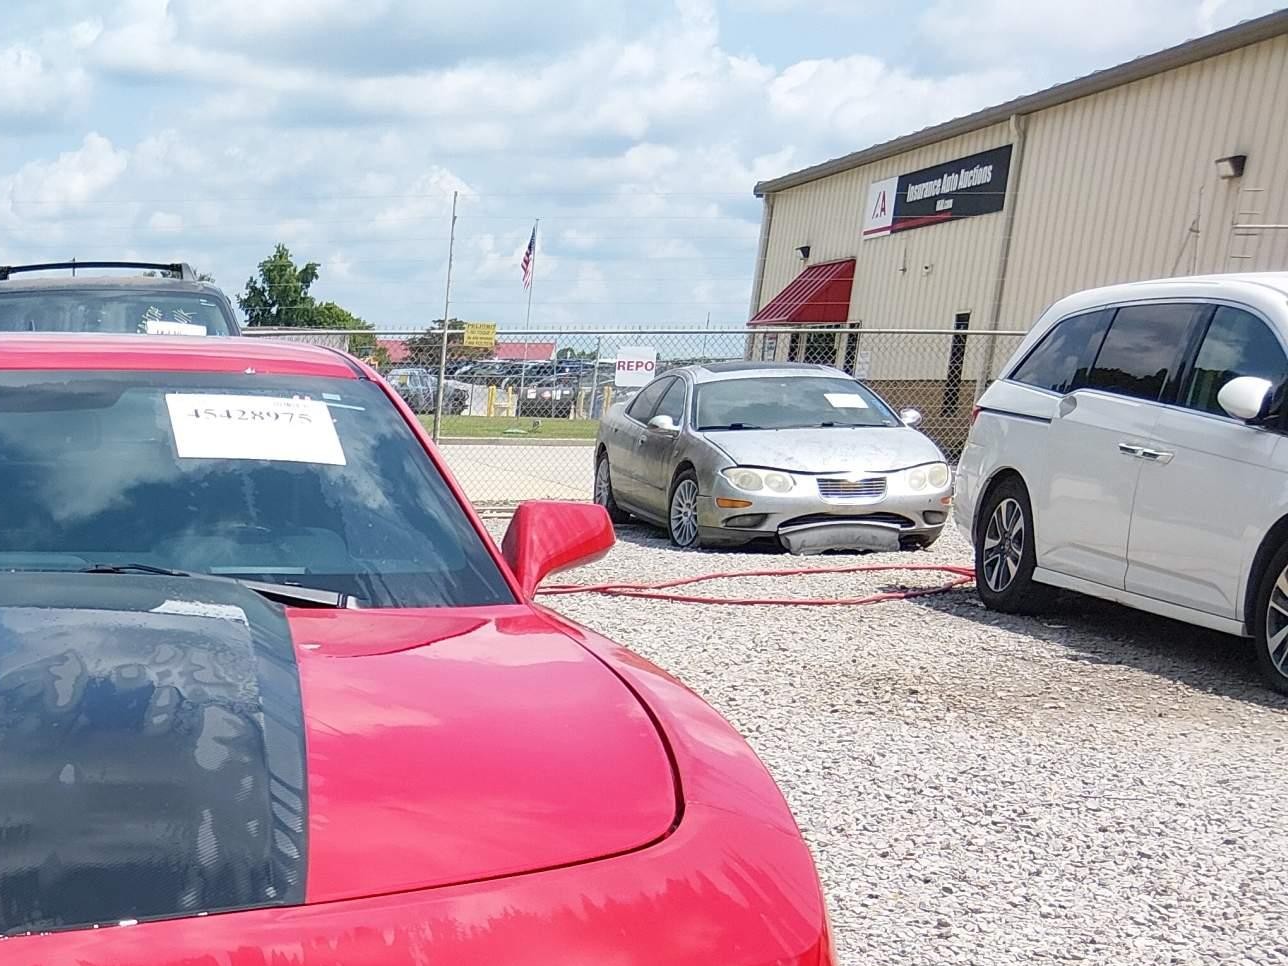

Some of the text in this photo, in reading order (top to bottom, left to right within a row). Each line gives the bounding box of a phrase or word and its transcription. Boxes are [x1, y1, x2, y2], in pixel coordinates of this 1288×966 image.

[906, 164, 993, 203] Insurance Auto Auctions
[617, 360, 655, 371] REPO
[187, 408, 313, 424] 45428975
